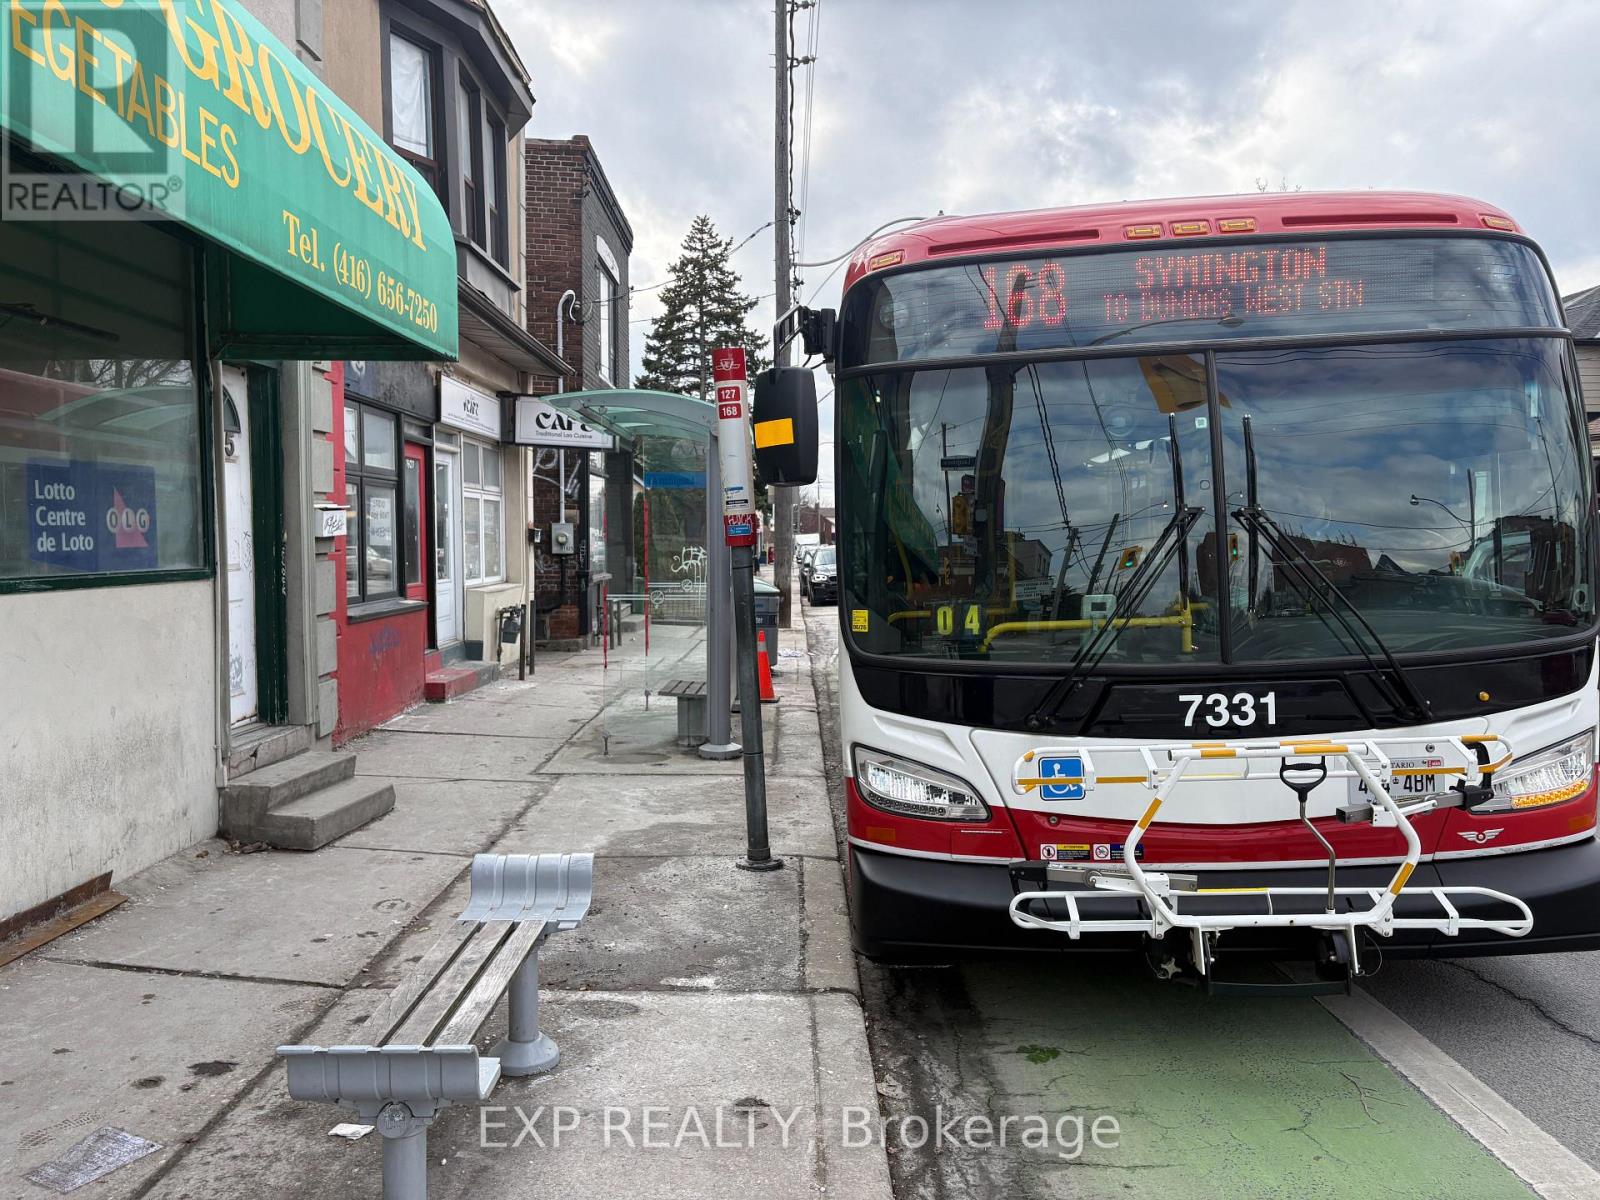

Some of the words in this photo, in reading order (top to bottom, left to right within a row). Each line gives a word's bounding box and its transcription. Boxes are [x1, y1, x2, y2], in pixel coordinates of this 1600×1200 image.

[11, 0, 240, 189] EGETABLES
[158, 0, 428, 252] GROCERY
[282, 209, 326, 272] Tel.
[333, 241, 372, 300] (416)
[377, 270, 438, 334] 656-7250
[1136, 247, 1326, 288] SYMINGTON
[983, 263, 1067, 329] 168
[1104, 293, 1128, 321] TO
[1141, 288, 1232, 320] DUNDAS
[1244, 283, 1304, 314] WEST
[1319, 279, 1365, 310] STN
[721, 389, 736, 400] 127
[722, 406, 738, 417] 168
[34, 479, 76, 500] Lotto
[35, 506, 87, 527] Centre
[37, 531, 57, 552] de
[61, 532, 94, 552] Loto
[964, 604, 980, 635] 4
[1178, 691, 1276, 727] 7331
[1391, 761, 1415, 769] TARIO
